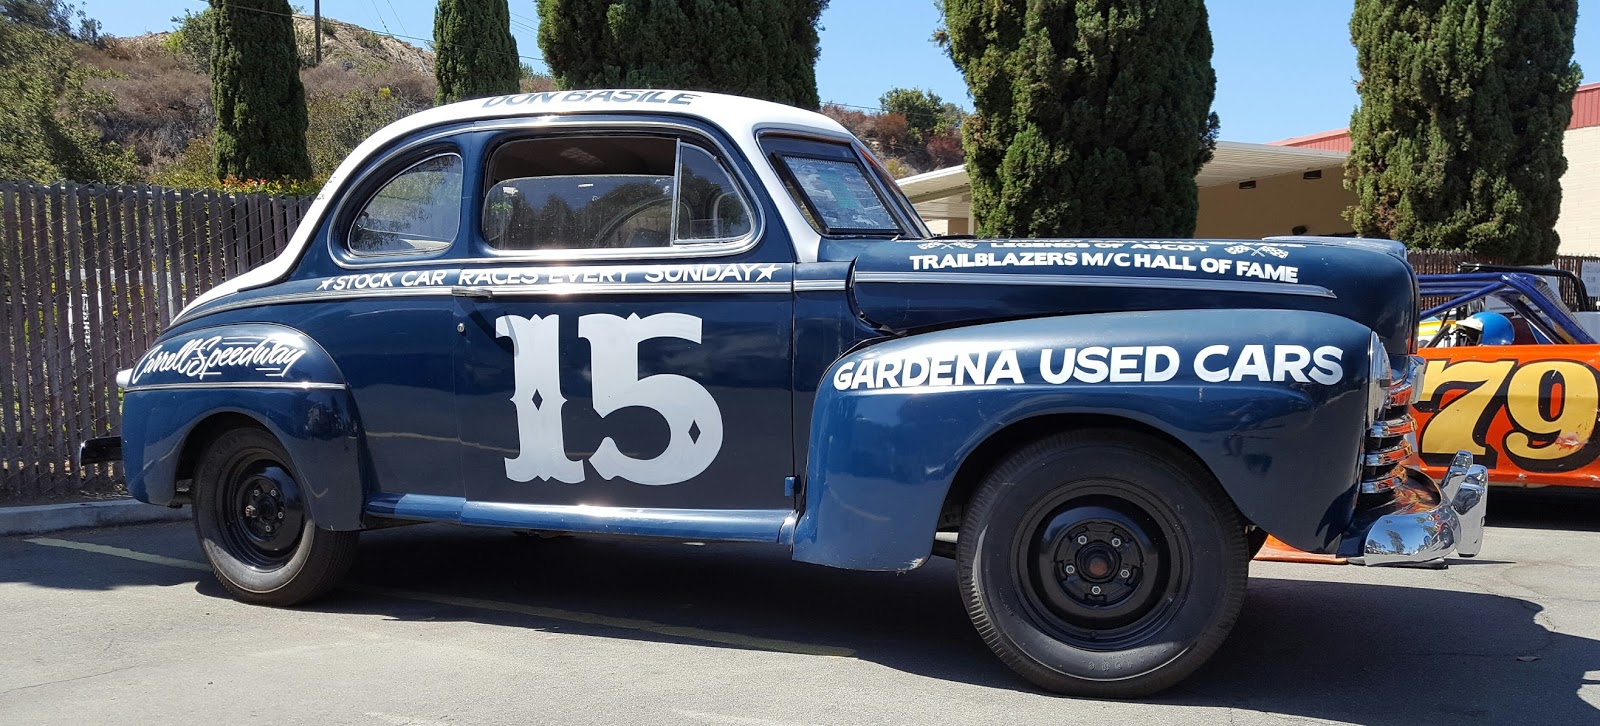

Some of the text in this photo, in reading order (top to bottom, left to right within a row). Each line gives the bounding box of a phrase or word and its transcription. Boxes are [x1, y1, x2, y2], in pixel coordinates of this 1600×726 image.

[482, 90, 702, 108] DON BASILE
[1130, 243, 1210, 252] ASCOT
[333, 263, 757, 291] STOCK CAR RACES EVERY SUNDAY
[909, 252, 1299, 283] TRAILBLAZERS M/C HALL OF FAME
[132, 336, 306, 384] Carrell Speedway
[833, 344, 1344, 391] GARDENA USED CARS
[495, 312, 724, 486] 15
[1415, 359, 1600, 473] 79
